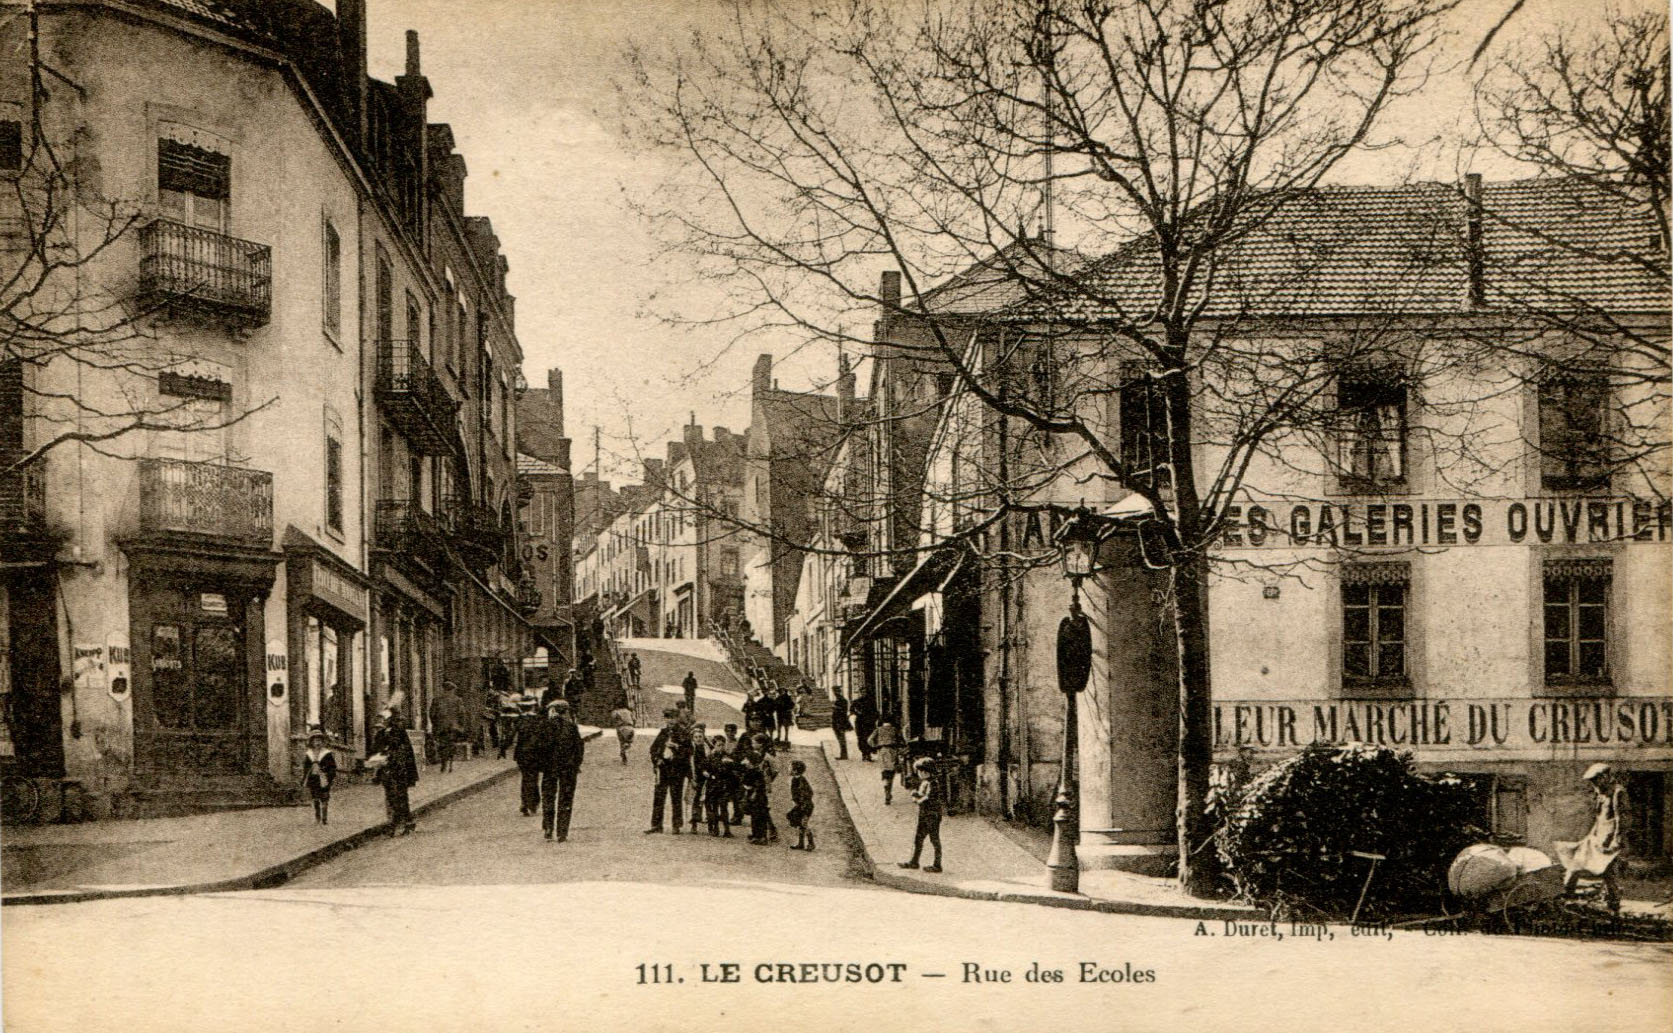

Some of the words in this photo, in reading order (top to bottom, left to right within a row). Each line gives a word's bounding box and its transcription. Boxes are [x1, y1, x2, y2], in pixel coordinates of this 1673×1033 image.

[1290, 503, 1483, 545] GALERIES
[1314, 700, 1450, 746] MARCHÉ
[1467, 703, 1511, 745] DU
